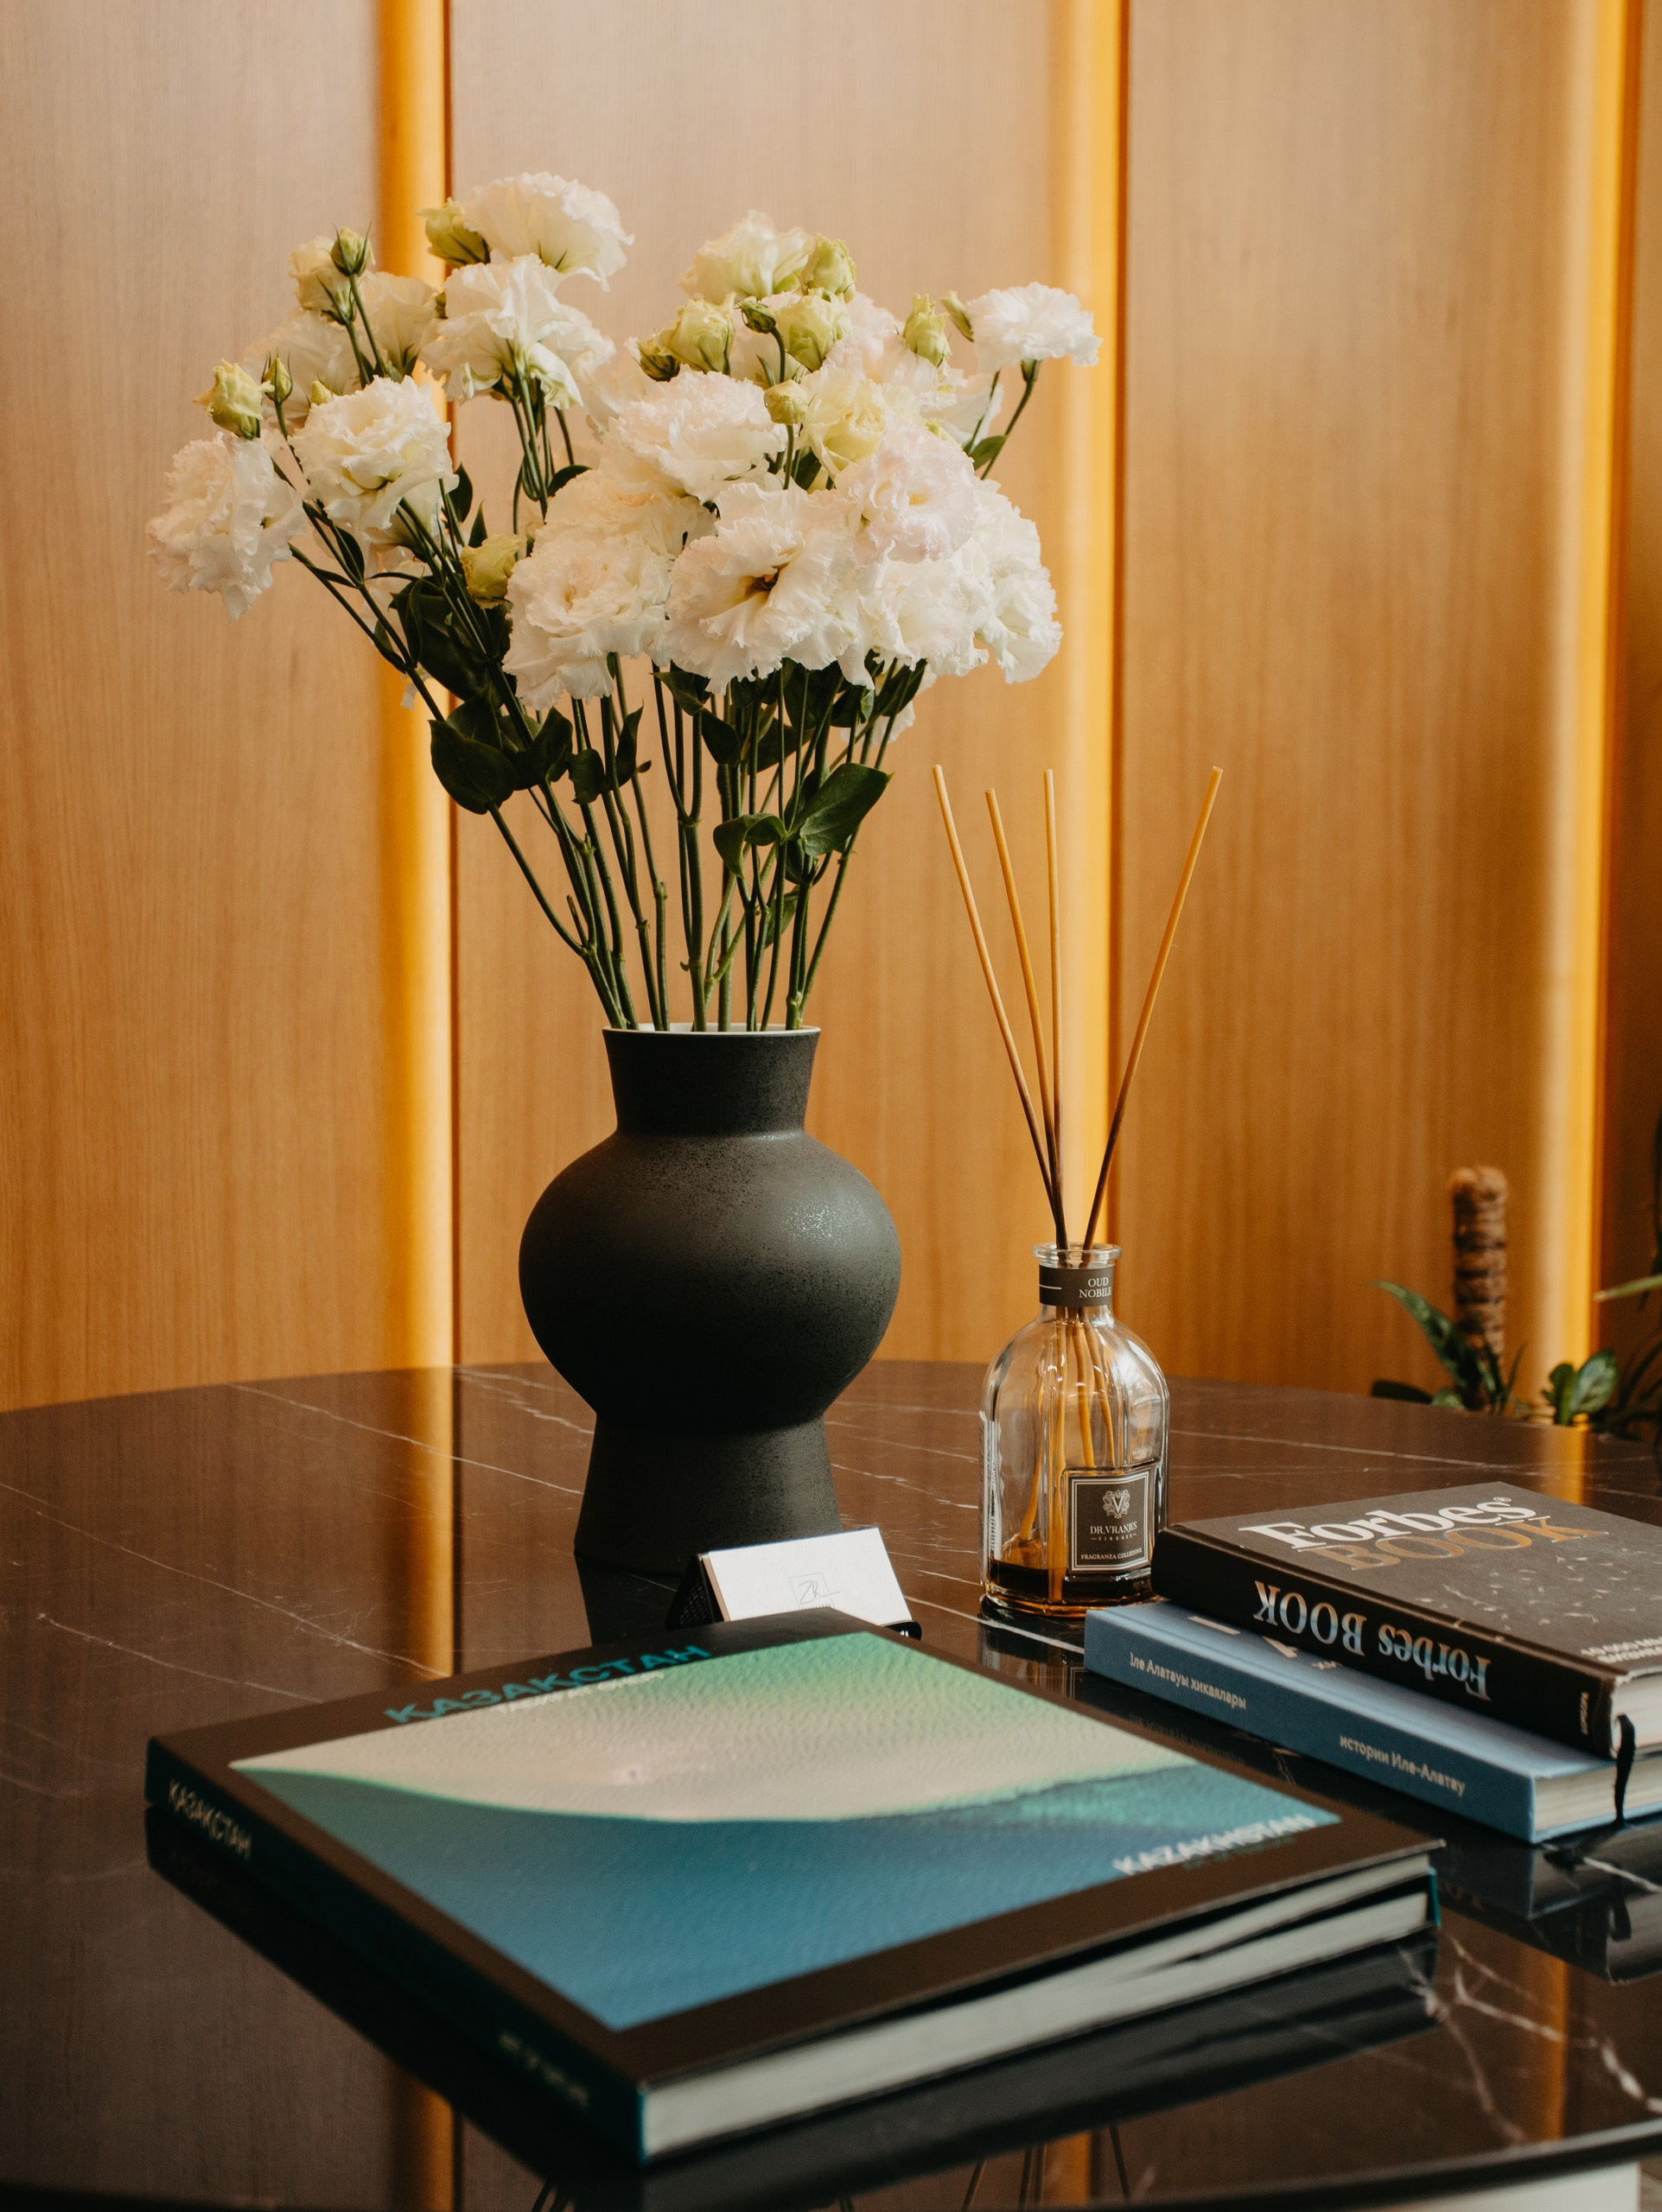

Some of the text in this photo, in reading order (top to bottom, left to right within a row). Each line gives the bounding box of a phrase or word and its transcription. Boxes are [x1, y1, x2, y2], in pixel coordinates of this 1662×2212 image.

[1079, 1287, 1112, 1298] NOBILE
[1088, 1277, 1109, 1287] OUD
[1238, 1501, 1537, 1549] Forbes
[1298, 1516, 1609, 1571] BOOK
[1253, 1580, 1367, 1657] BOOK
[1146, 1659, 1189, 1688] Алатауы
[1190, 1677, 1246, 1710] хикаялары
[1379, 1624, 1492, 1702] Forbes
[1340, 1734, 1466, 1797] истории Иле-Алатау
